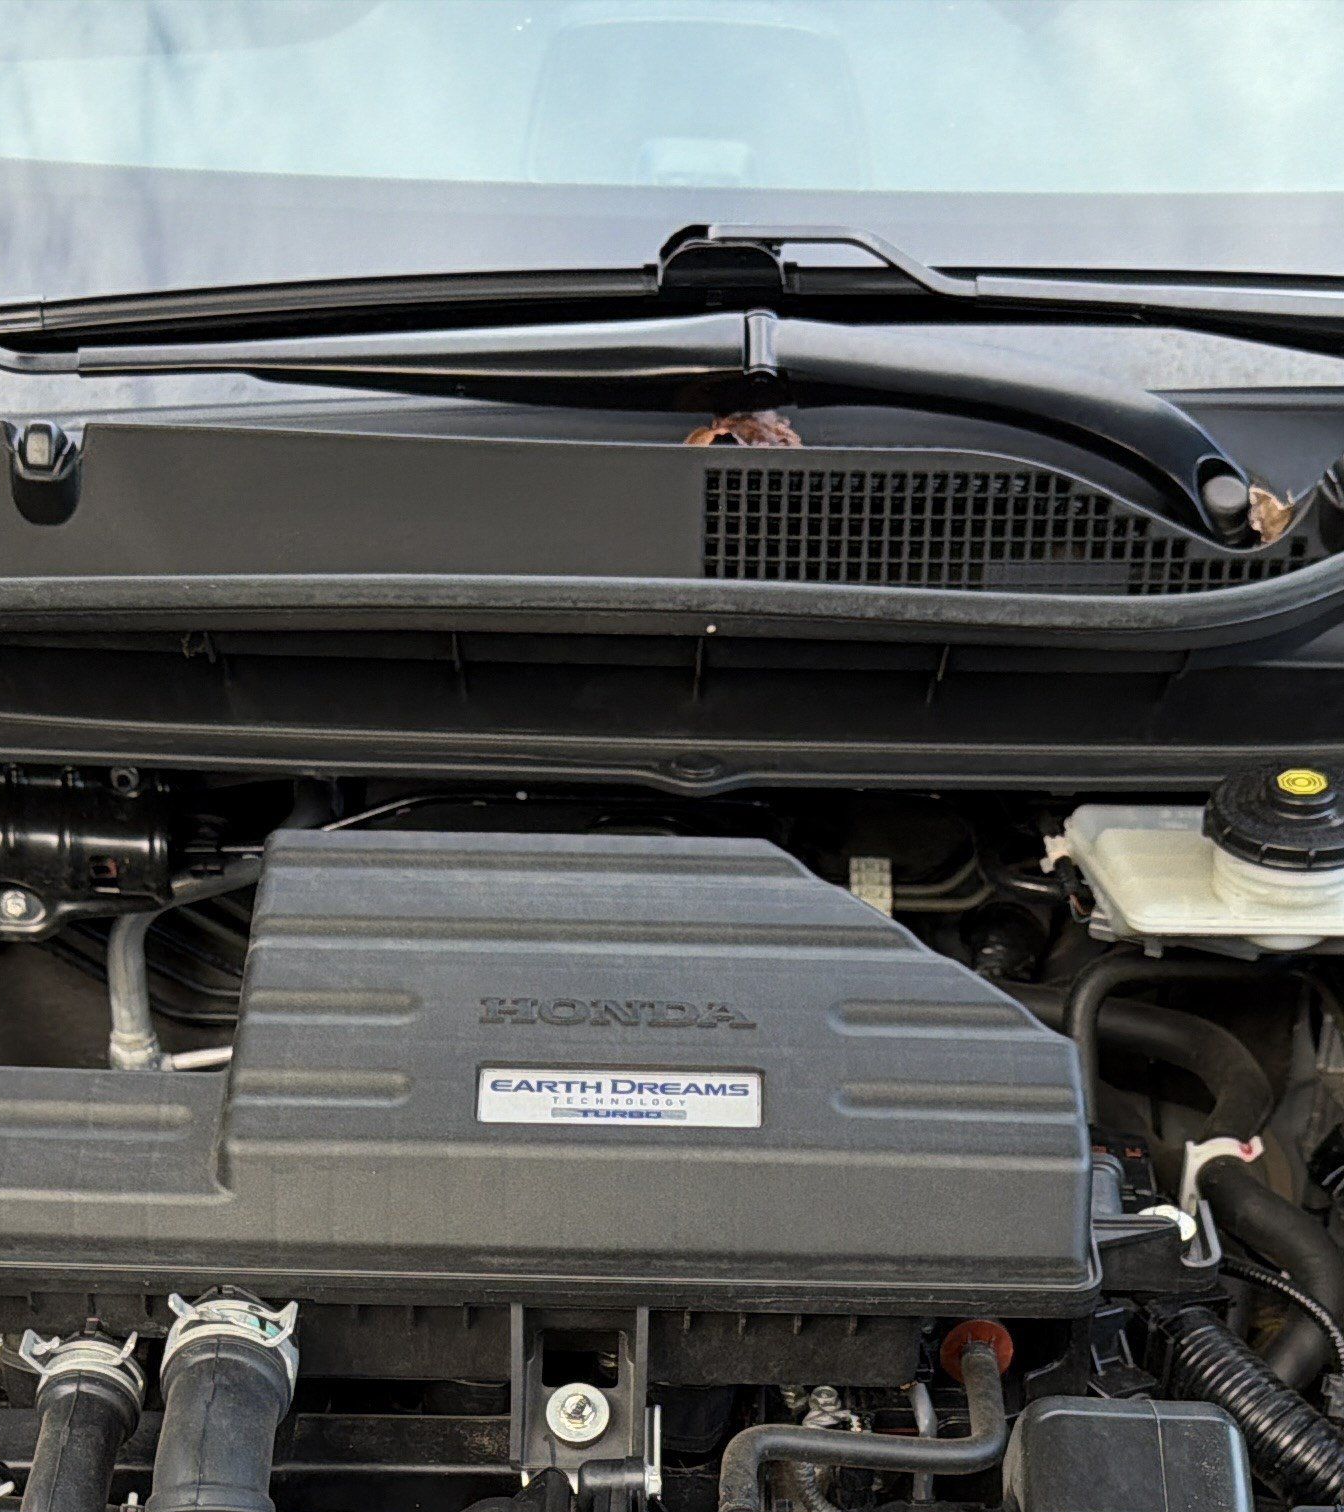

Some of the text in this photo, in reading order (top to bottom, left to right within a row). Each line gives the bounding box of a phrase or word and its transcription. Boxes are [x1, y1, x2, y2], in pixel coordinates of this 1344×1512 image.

[479, 997, 757, 1030] HONDA
[490, 1078, 750, 1097] EARTH DREAMS
[552, 1096, 687, 1107] TECHNOLOGY
[579, 1110, 663, 1119] TURBO
